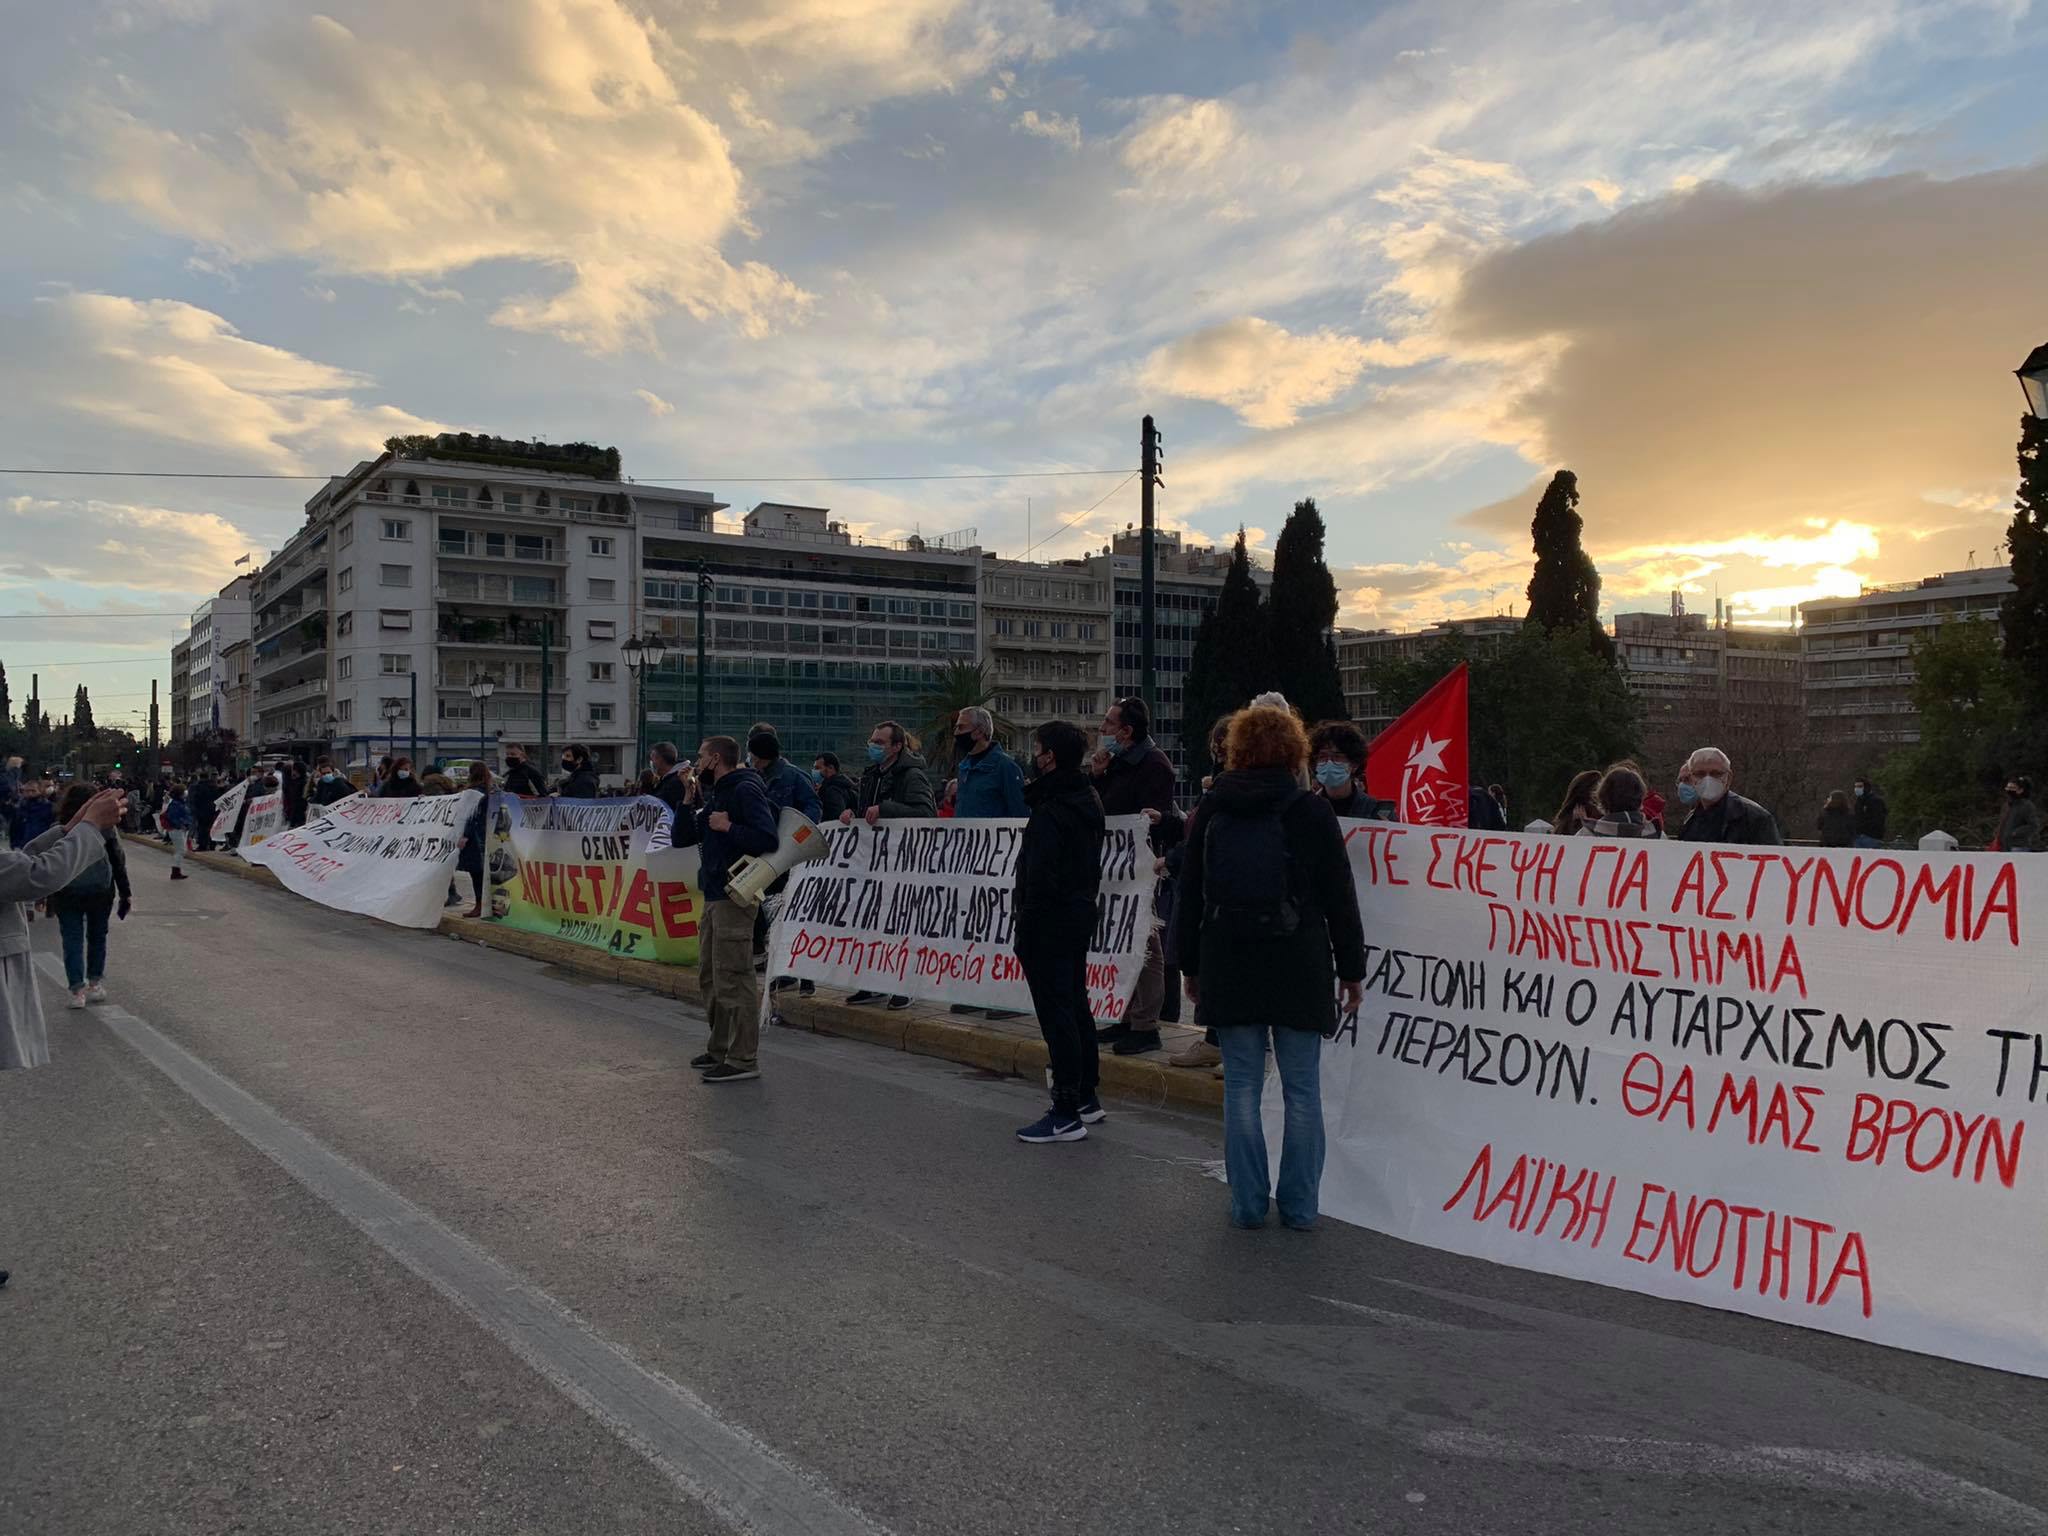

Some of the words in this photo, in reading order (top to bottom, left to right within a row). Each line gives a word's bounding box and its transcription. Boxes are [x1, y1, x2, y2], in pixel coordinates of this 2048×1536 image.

[581, 835, 631, 861] ΟΣΜΕ
[868, 826, 890, 872] ΤΑ
[1427, 834, 1564, 905] ΣΚΕΨΗ
[1578, 846, 1650, 911] ΓΙΑ
[1672, 851, 2019, 946] ΑΣΤΥΝΟΜΙΑ
[851, 878, 883, 930] ΓΙΑ
[1488, 902, 1808, 999] ΠΑΝΕΠΙΣΤΗΜΙΑ
[1503, 970, 1551, 1018] ΚΑΙ
[1566, 978, 1598, 1026] Ο
[1611, 981, 1953, 1089] ΑΥΤΑΡΧΙΣΜΟΣ
[1378, 1012, 1599, 1105] ΠΕΡΑΣΟΥΝ.
[1621, 1051, 1696, 1131] ΘΑ
[1707, 1071, 1824, 1153] ΜΑΣ
[1846, 1093, 2025, 1188] ΒΡΟΥΝ
[1443, 1142, 1616, 1249] ΛΑΪΚΗ
[1623, 1182, 1873, 1318] ΕΝΟΤΗΤΑ
